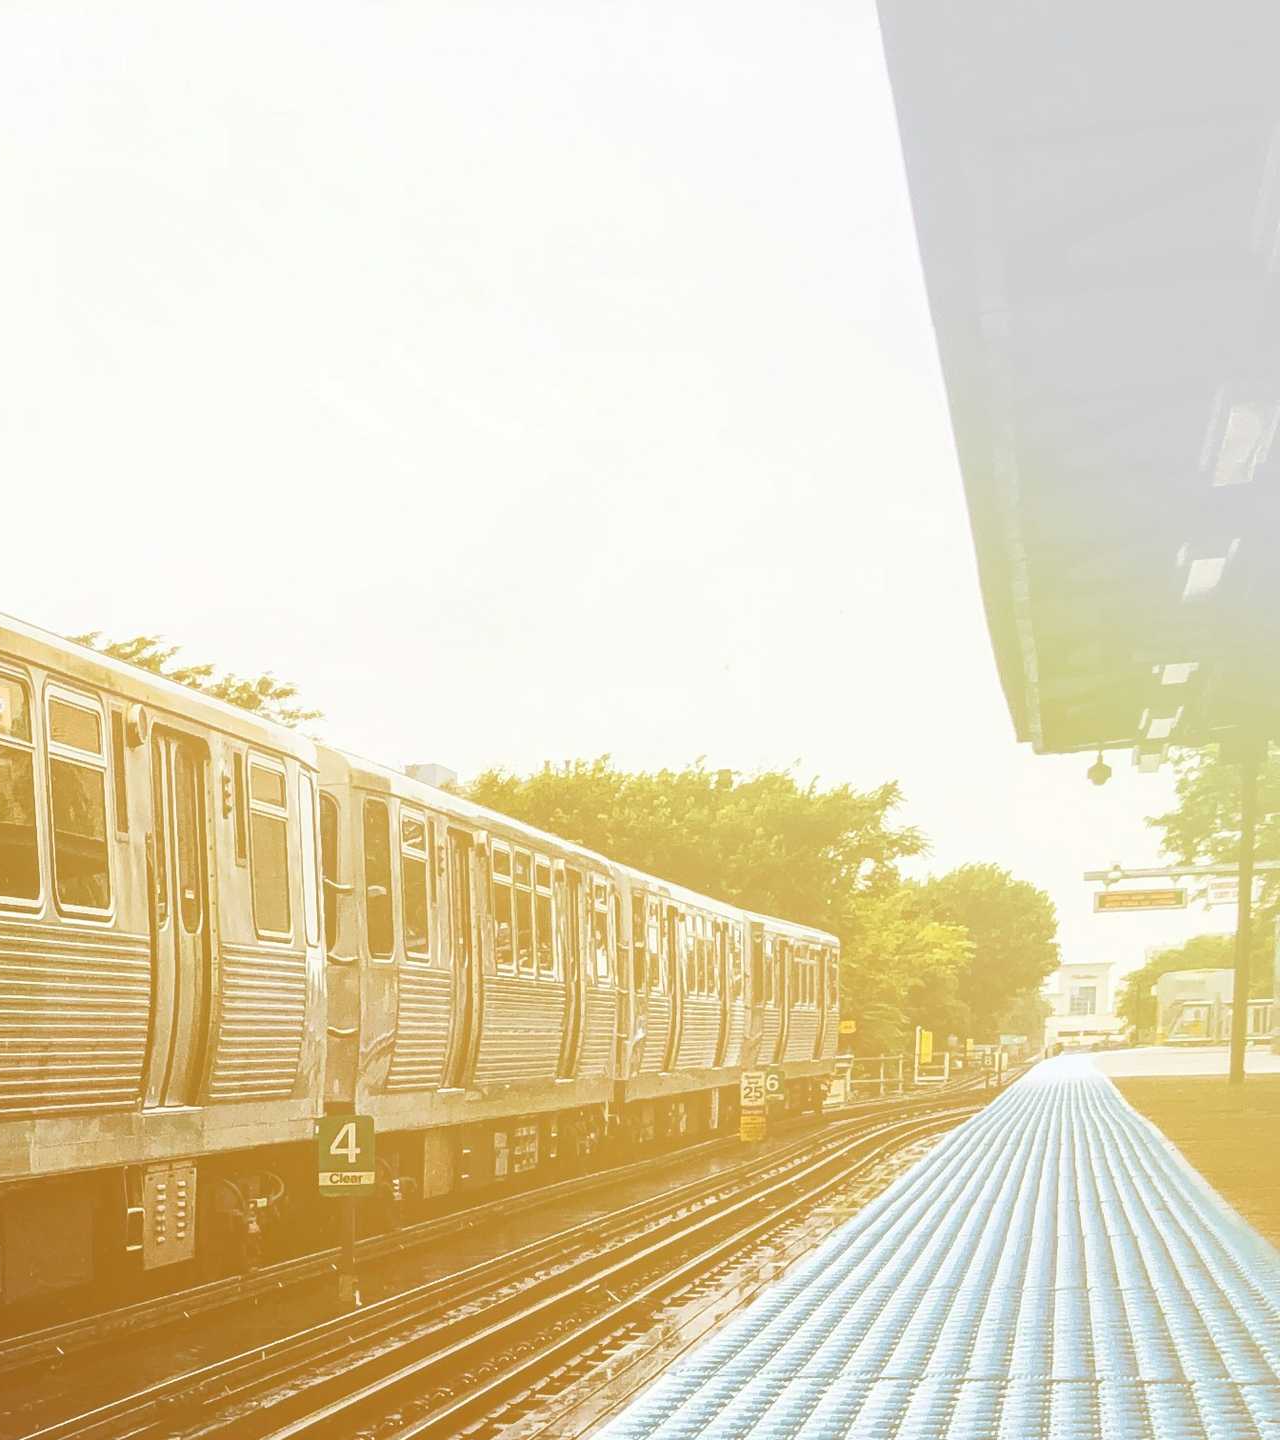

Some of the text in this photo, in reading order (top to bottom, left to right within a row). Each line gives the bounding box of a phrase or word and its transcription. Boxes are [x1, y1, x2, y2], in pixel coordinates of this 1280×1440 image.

[766, 1074, 779, 1091] 6
[743, 1086, 764, 1099] 25
[329, 1122, 361, 1164] 4
[329, 1173, 364, 1184] Clear
